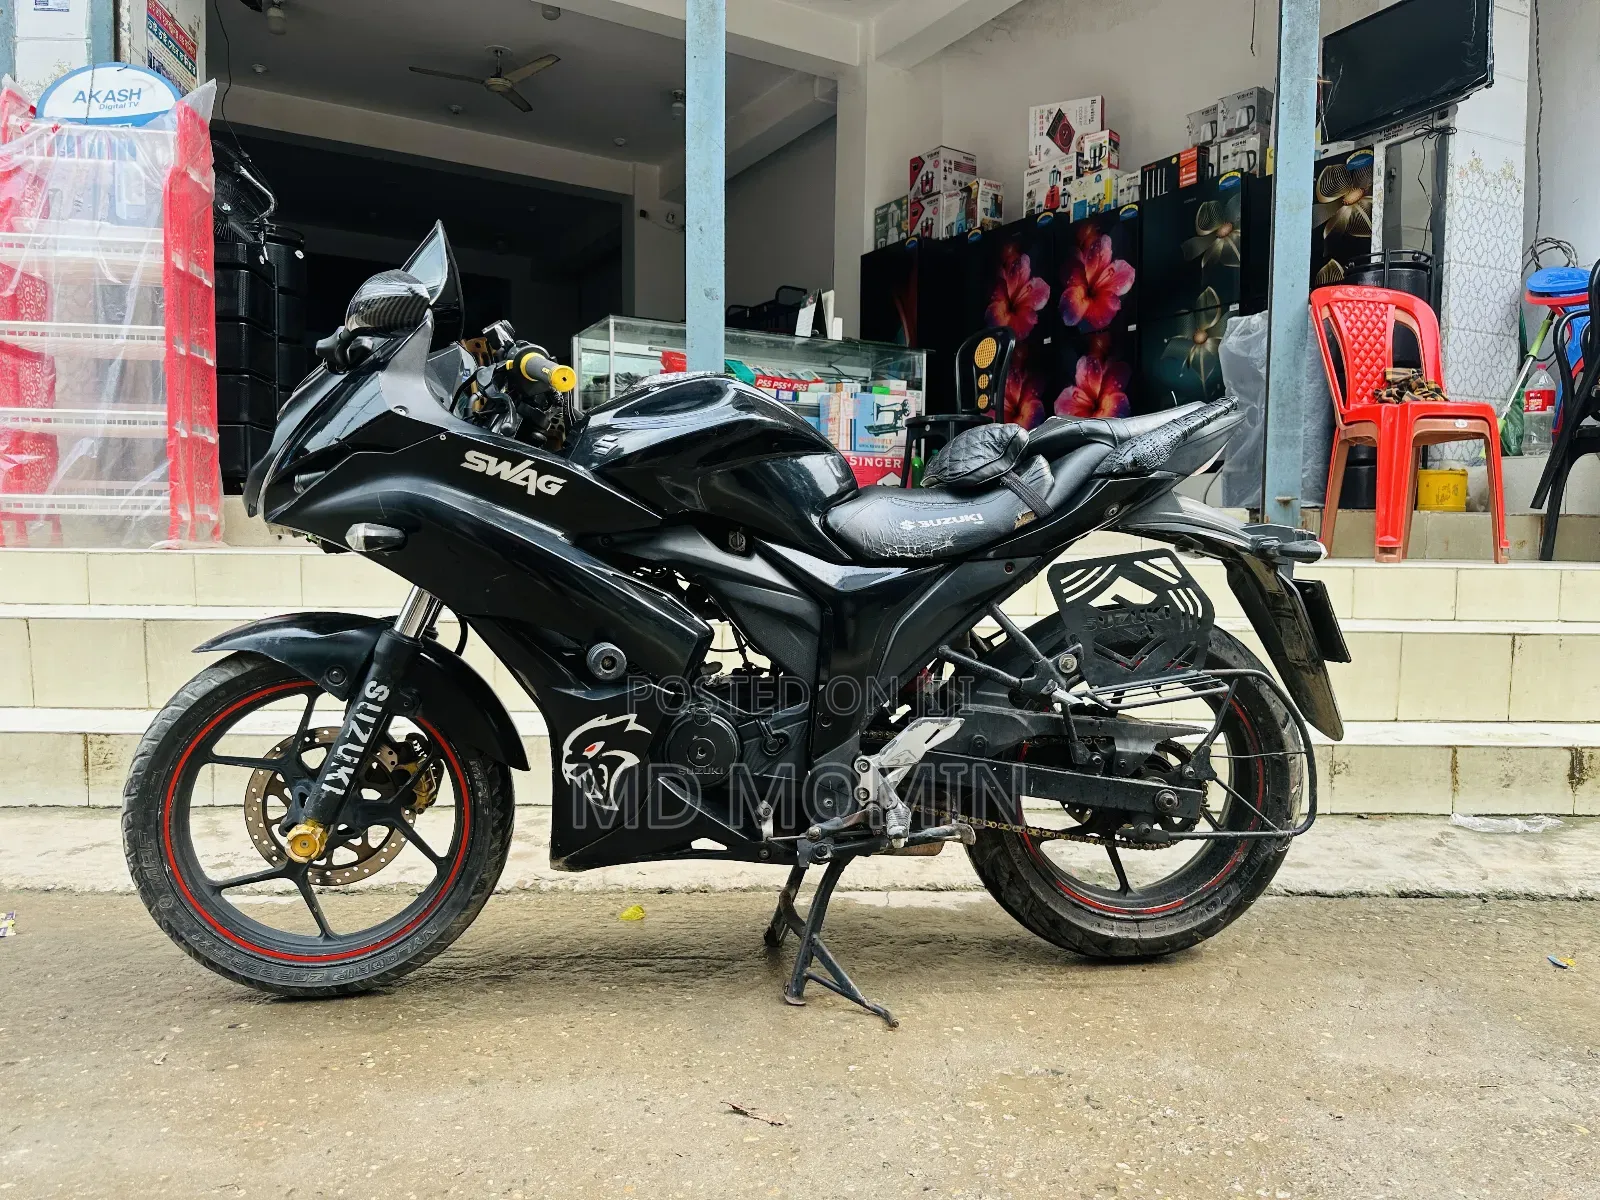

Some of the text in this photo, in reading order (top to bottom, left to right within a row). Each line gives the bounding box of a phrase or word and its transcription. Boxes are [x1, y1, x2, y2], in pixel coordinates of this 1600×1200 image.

[72, 87, 142, 104] AKASH
[99, 103, 126, 111] Digital
[850, 456, 902, 469] SINGER
[460, 450, 568, 497] SWAG
[918, 513, 984, 529] SUZUKI
[321, 680, 390, 796] SUZUKI
[678, 767, 724, 776] SUZUKI
